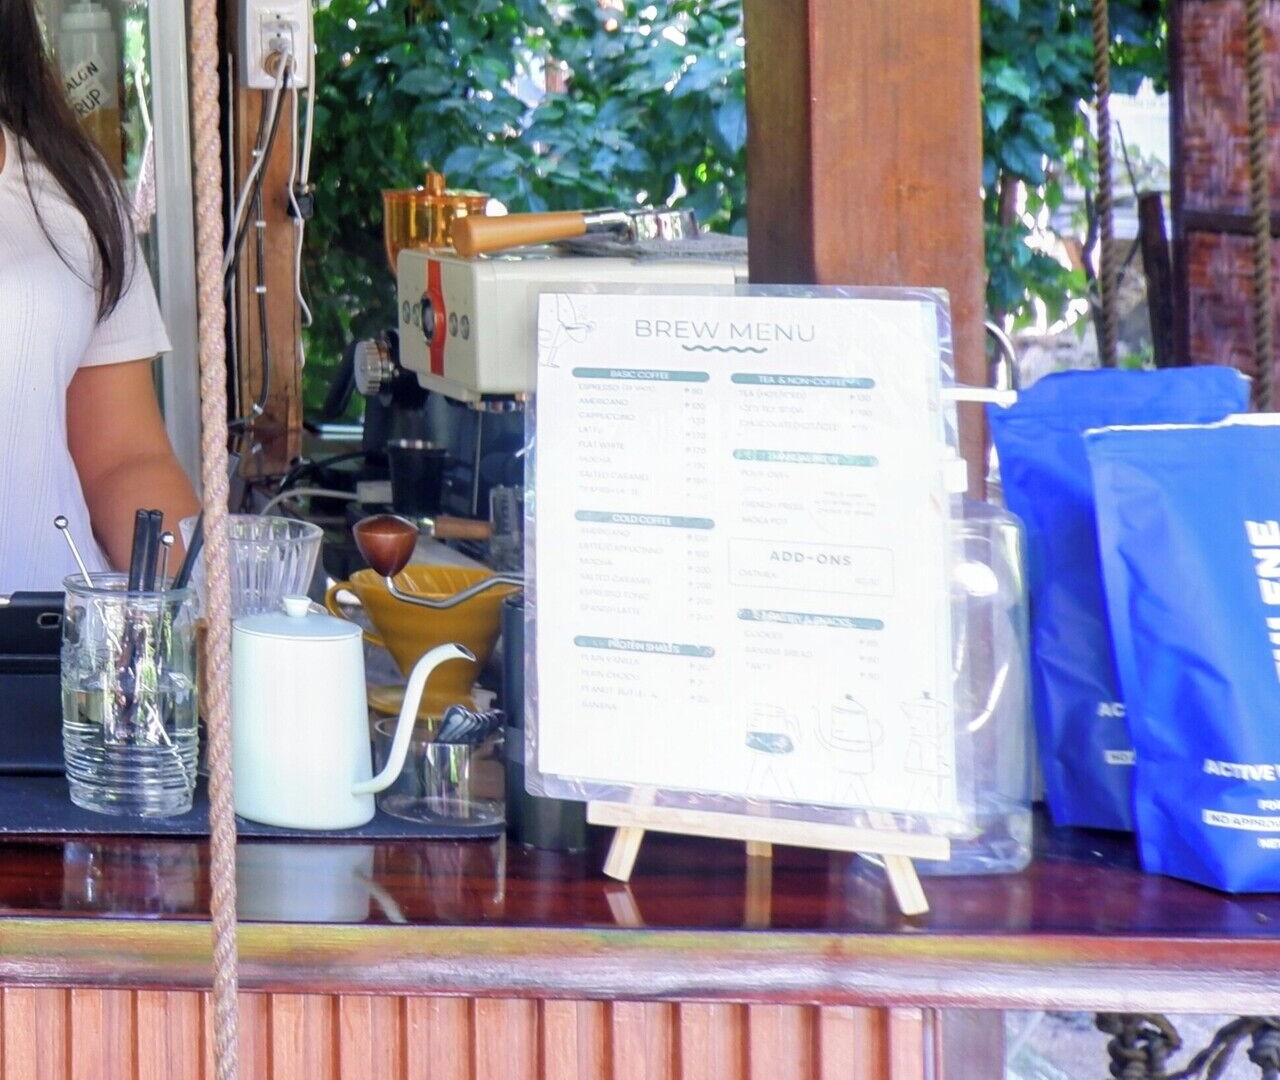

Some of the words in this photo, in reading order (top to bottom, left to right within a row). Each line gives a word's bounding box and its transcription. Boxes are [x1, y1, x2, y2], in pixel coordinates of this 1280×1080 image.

[635, 319, 720, 340] BREW
[730, 322, 816, 343] MENU
[609, 370, 635, 379] BASIC
[637, 371, 670, 380] COFFEE
[758, 375, 776, 384] TEA
[611, 514, 637, 524] COLD
[638, 516, 671, 525] COFFEE
[769, 550, 853, 567] ADD-ONS
[1203, 758, 1277, 782] ACTIVE
